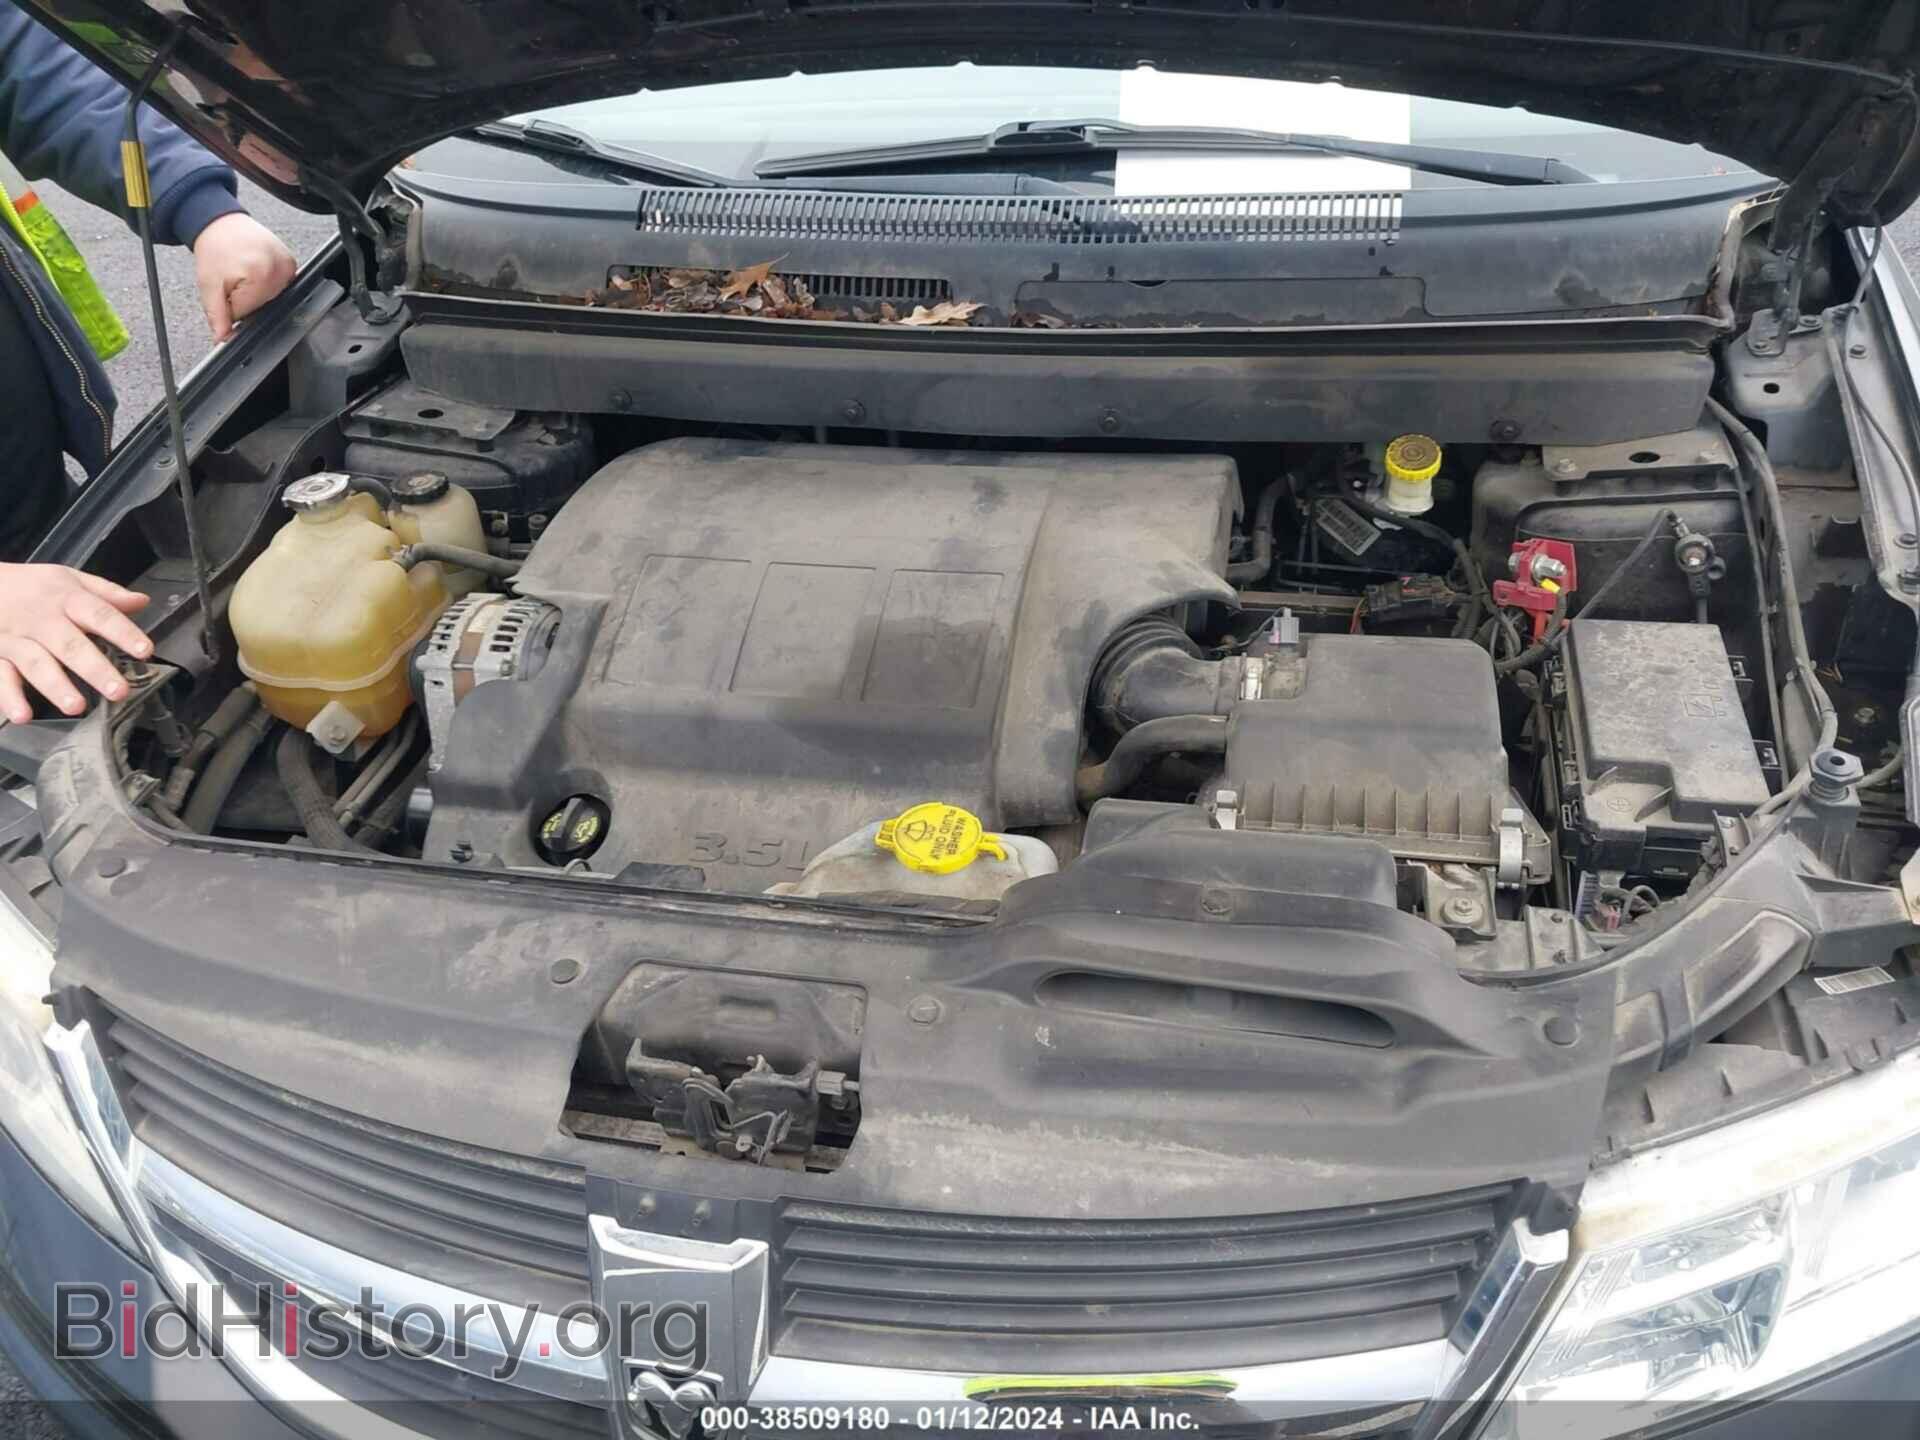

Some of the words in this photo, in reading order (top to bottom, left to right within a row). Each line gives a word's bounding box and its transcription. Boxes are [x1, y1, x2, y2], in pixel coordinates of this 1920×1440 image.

[939, 809, 957, 834] FLUID
[930, 836, 947, 860] ONLY
[945, 817, 966, 856] WASHER
